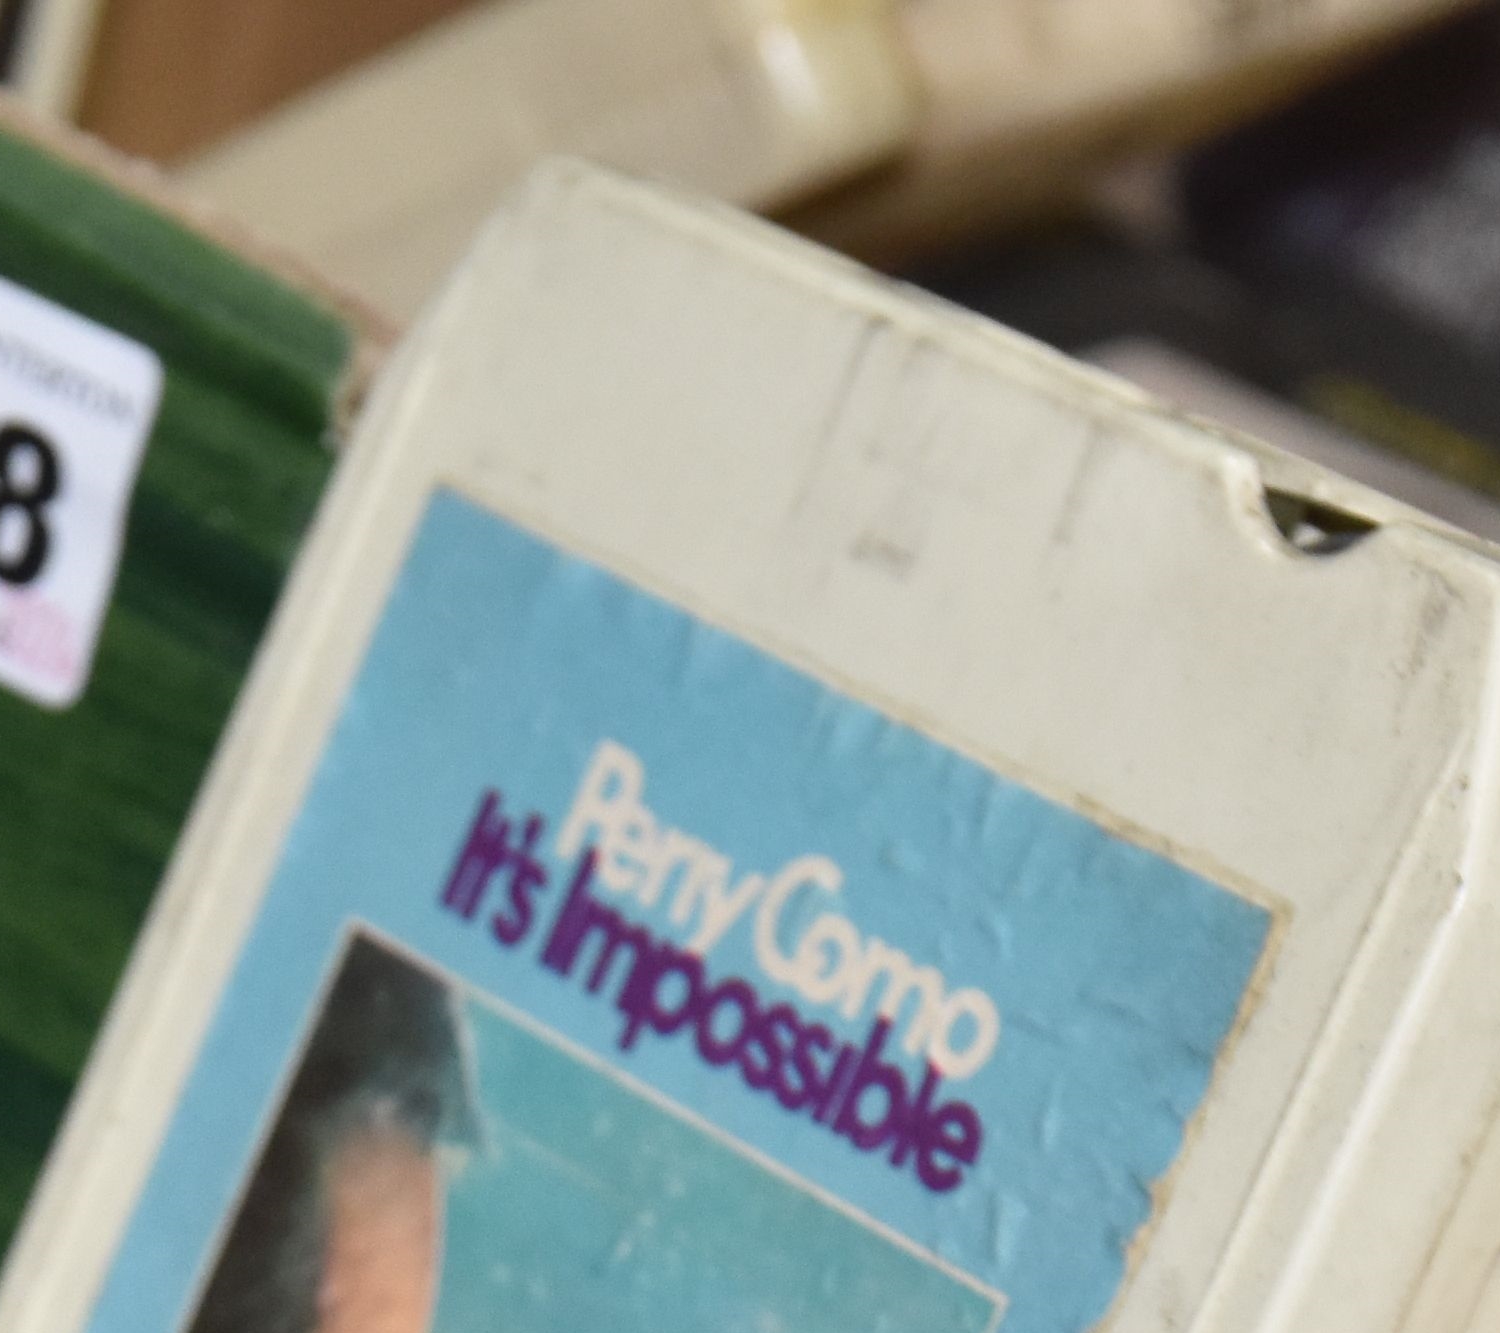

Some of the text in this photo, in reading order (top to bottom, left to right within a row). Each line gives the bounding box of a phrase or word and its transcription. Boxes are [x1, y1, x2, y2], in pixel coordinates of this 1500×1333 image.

[437, 787, 982, 1195] It's Impossible
[553, 738, 1000, 1079] Perry Como
